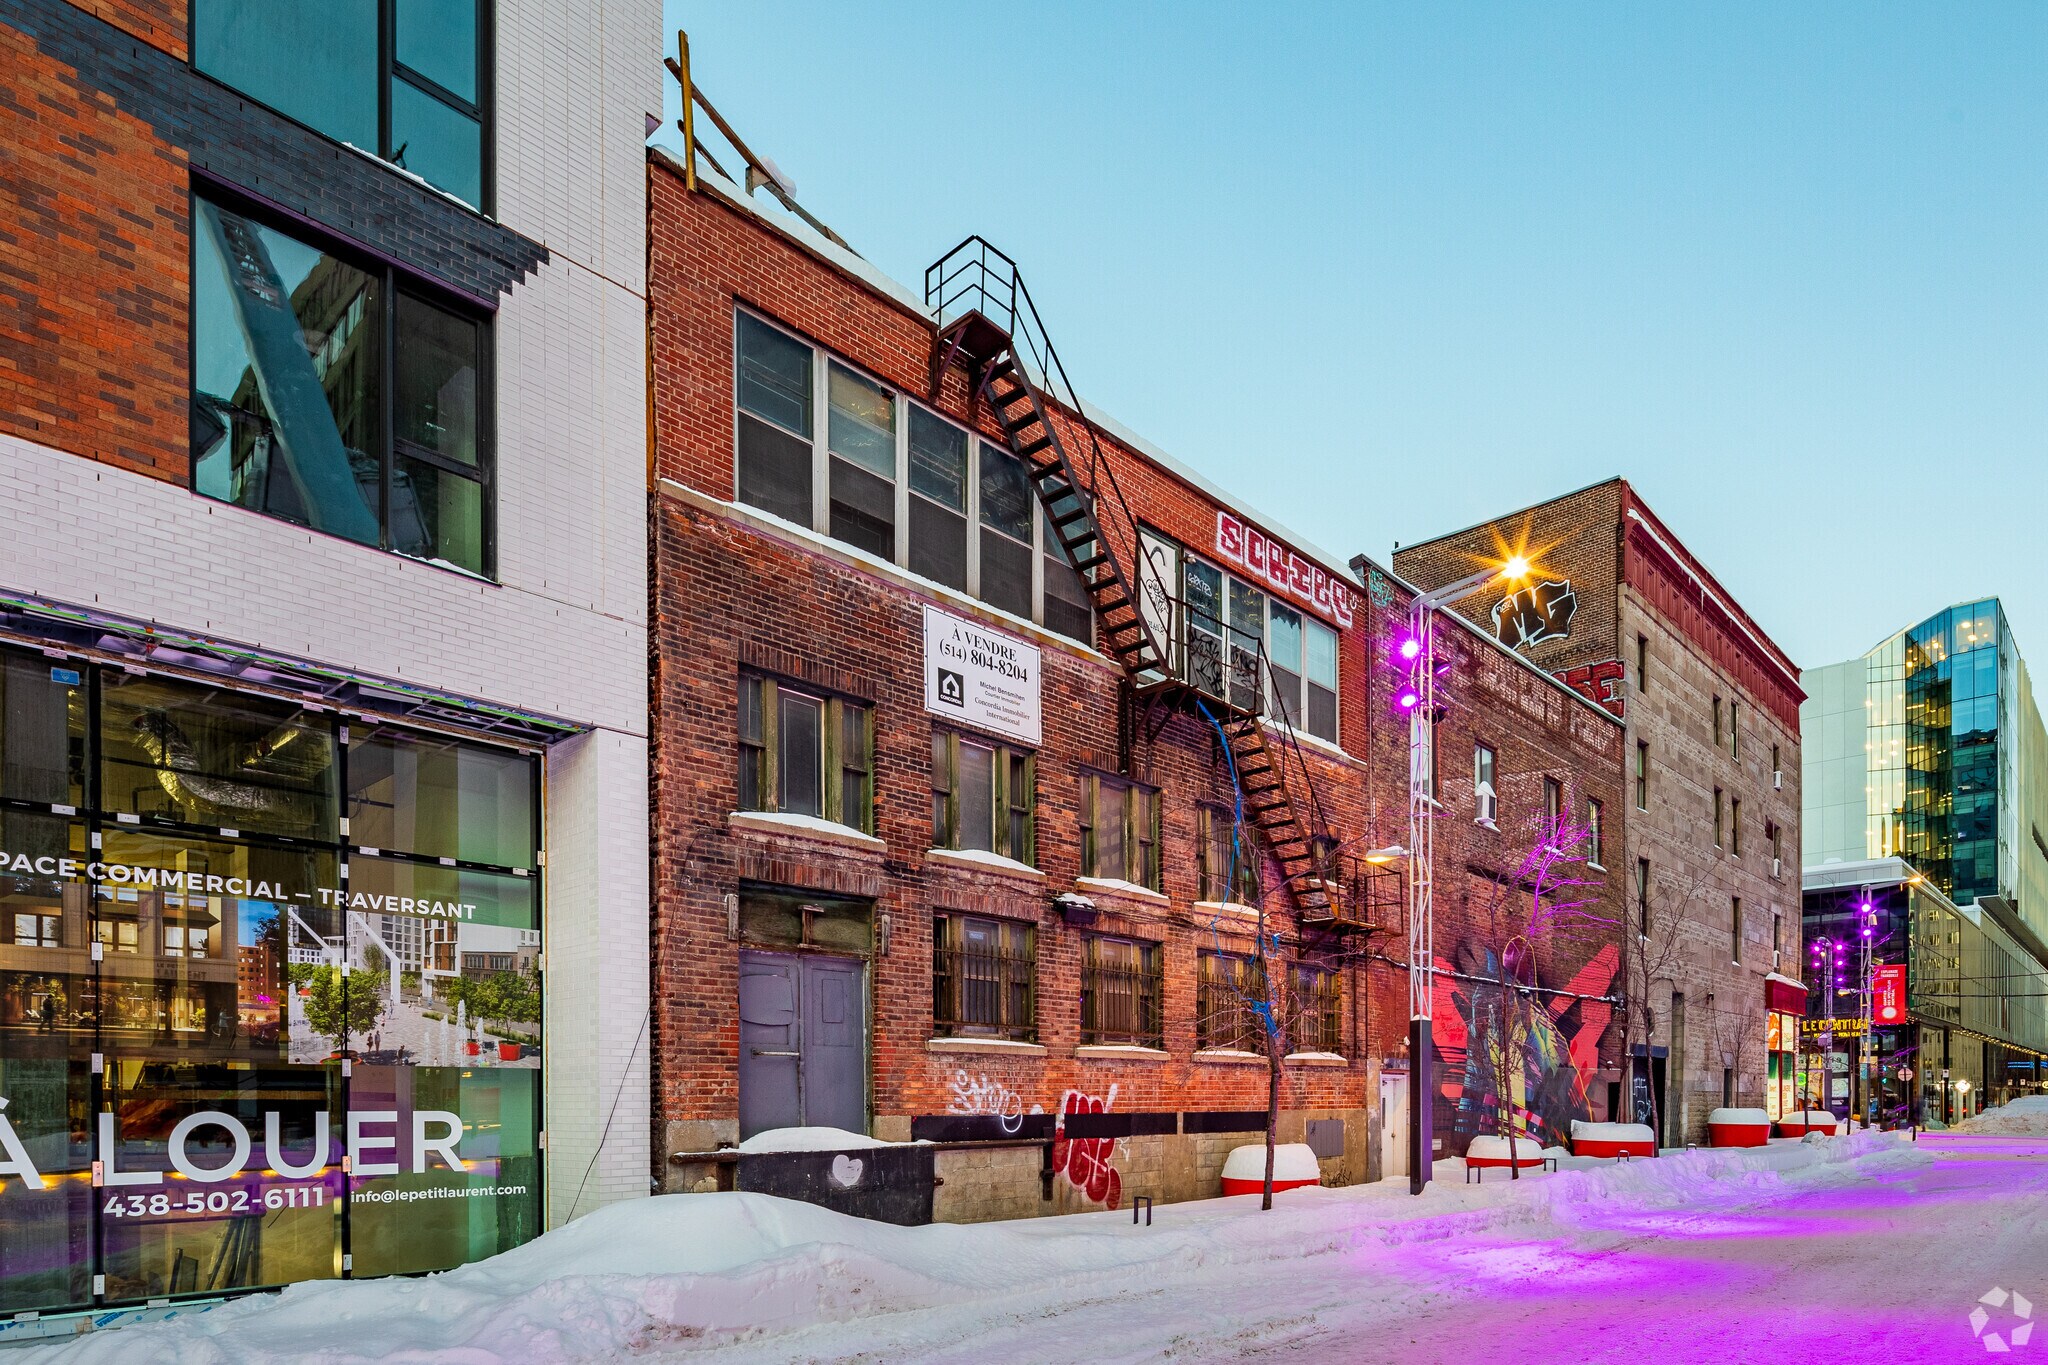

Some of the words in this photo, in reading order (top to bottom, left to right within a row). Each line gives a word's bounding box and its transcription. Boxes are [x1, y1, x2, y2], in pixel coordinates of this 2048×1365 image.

[952, 623, 961, 641] À
[964, 631, 1017, 662] VENDRE
[939, 638, 967, 663] (514)
[970, 650, 1028, 682] 804-8204
[980, 681, 997, 692] Michel
[975, 697, 1001, 711] Concordia
[1002, 705, 1030, 720] Immobilier
[986, 710, 1020, 726] International
[87, 862, 288, 900] COMMERCIAL
[317, 888, 477, 920] TRAVERSANT
[1802, 1020, 1817, 1032] LE
[99, 1110, 468, 1187] LOUER
[104, 1187, 323, 1218] 438-502-6111
[351, 1184, 527, 1204] info@lepetitlaurent.com
